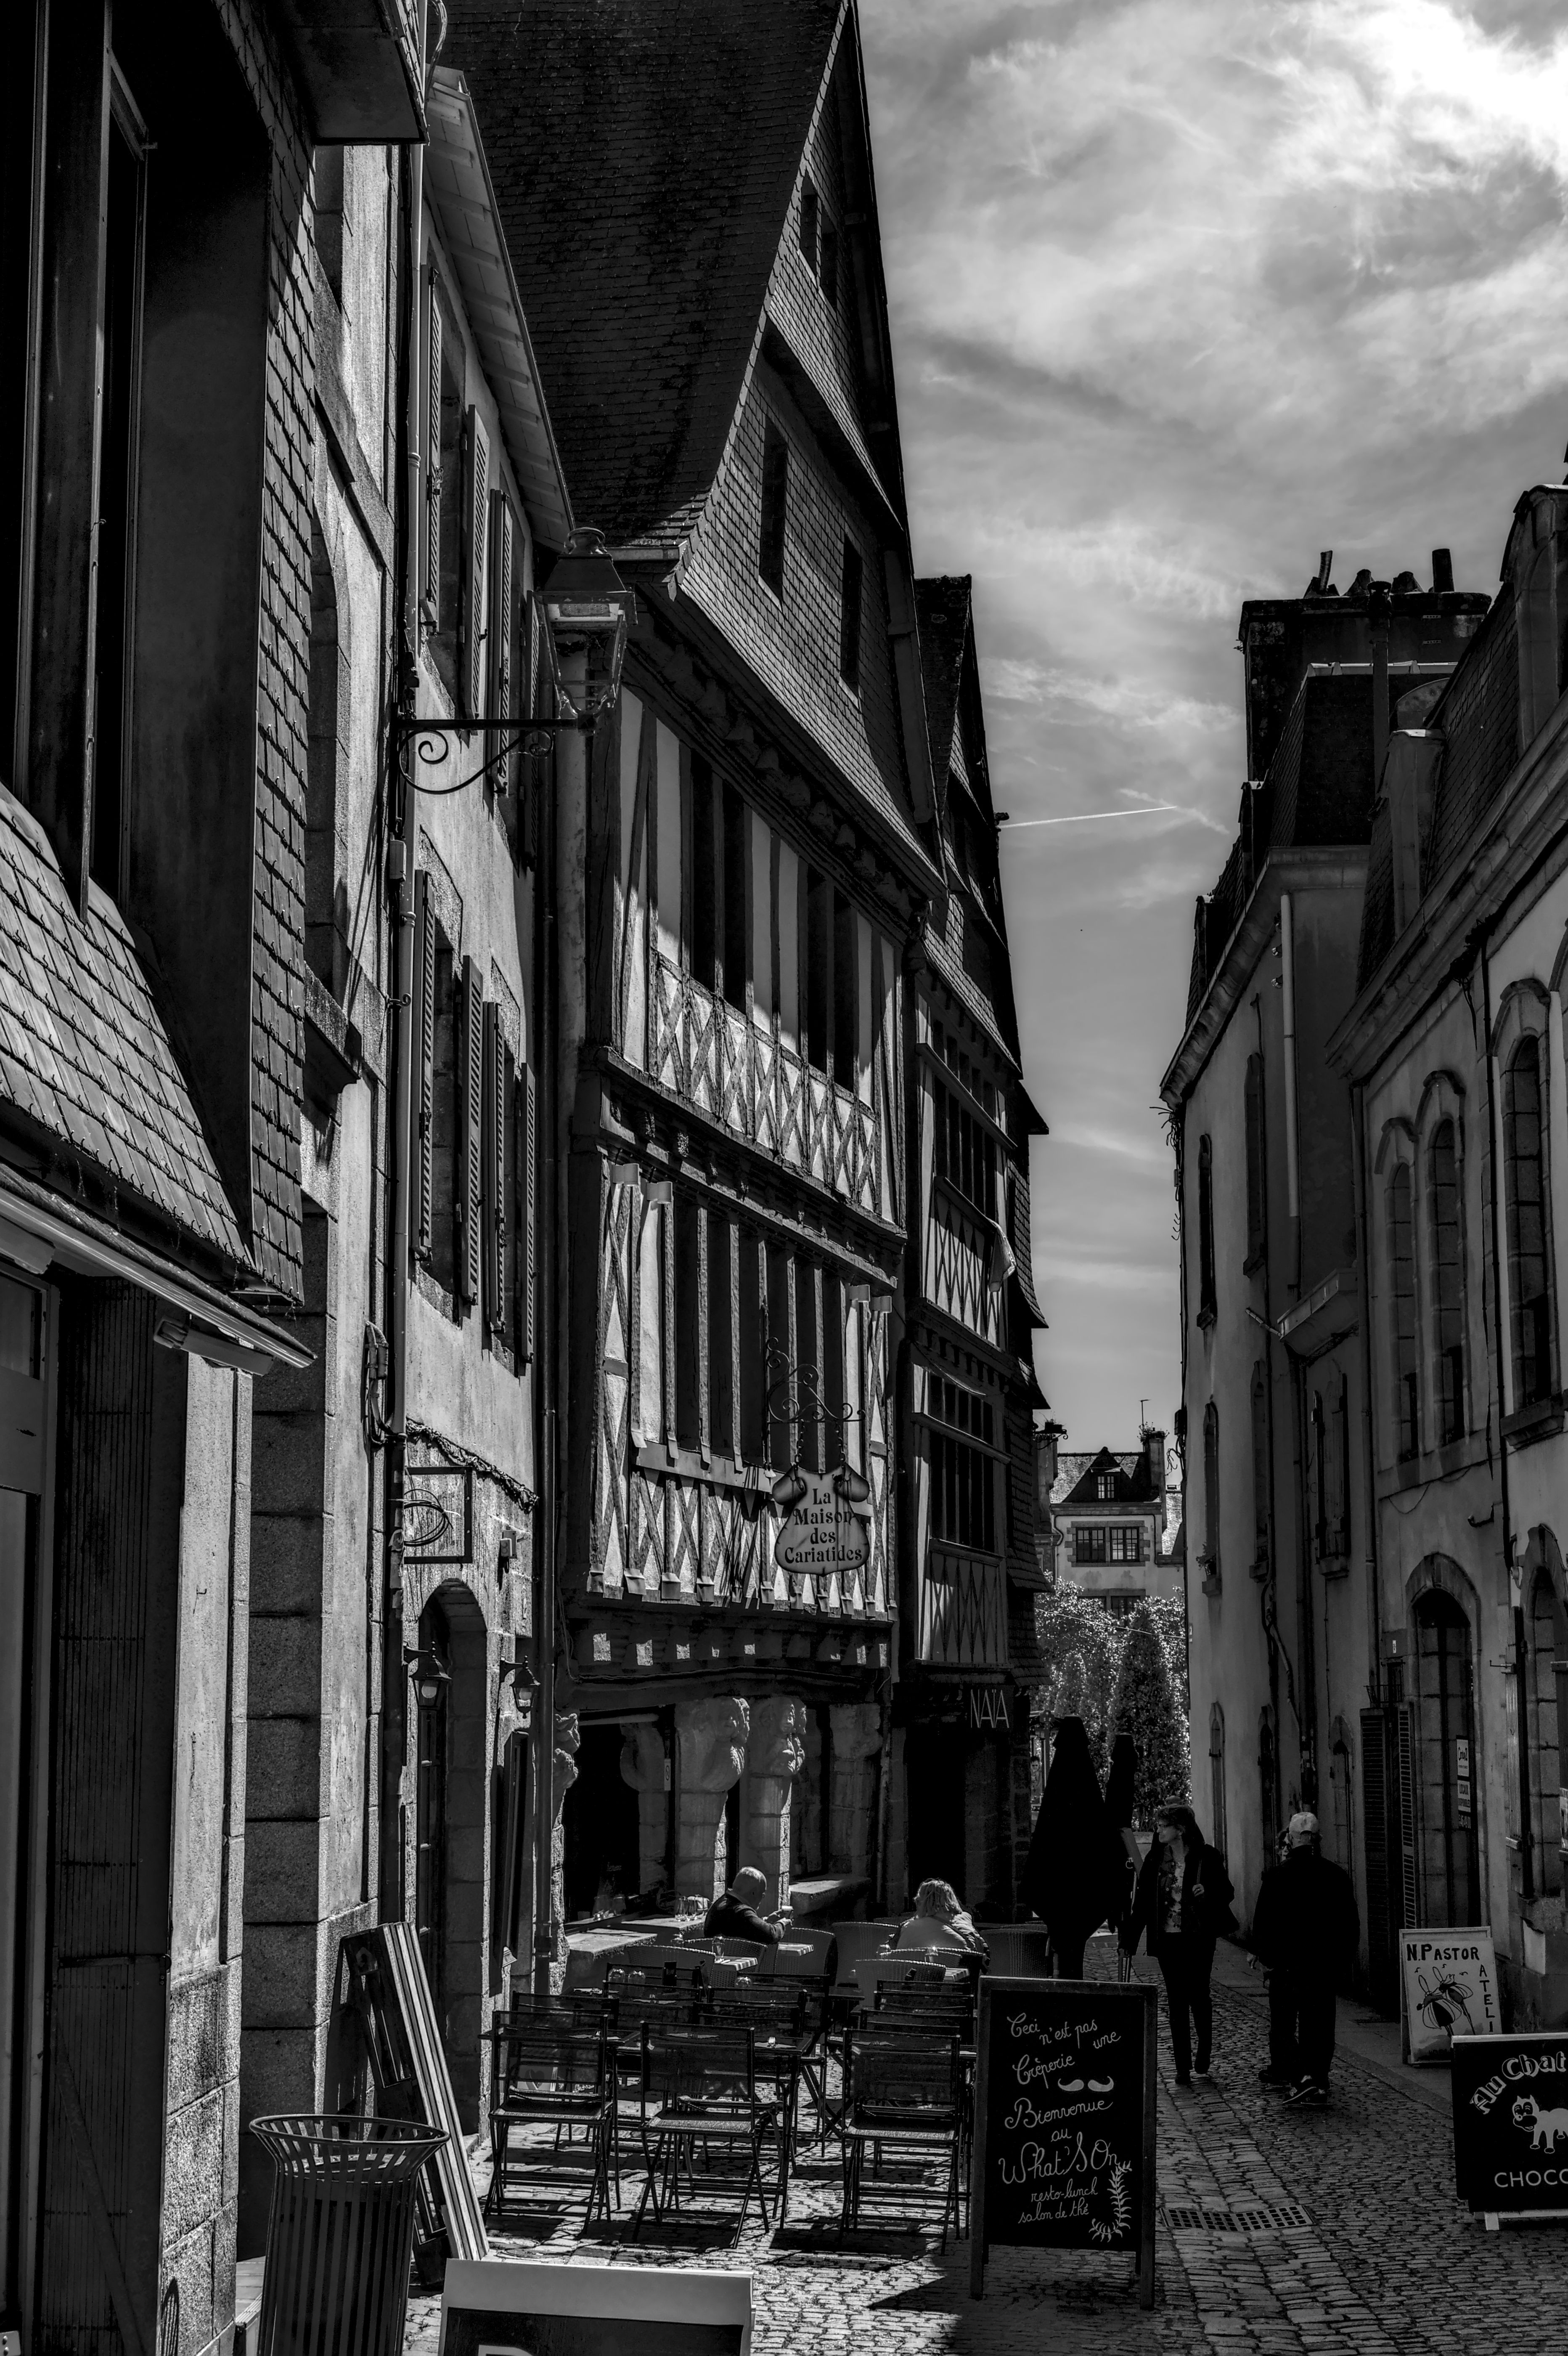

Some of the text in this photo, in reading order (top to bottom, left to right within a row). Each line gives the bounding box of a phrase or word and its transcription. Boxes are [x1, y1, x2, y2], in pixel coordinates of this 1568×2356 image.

[812, 1488, 832, 1505] La
[793, 1507, 852, 1526] Maison
[810, 1528, 836, 1544] des
[784, 1545, 862, 1564] Cariatides
[1479, 1964, 1495, 2032] ATELI
[1006, 2012, 1098, 2049] Ceci n'est pas
[1092, 2031, 1122, 2049] une
[1469, 2051, 1567, 2115] Au Chat
[1004, 2097, 1114, 2129] Bienvenue
[1051, 2128, 1073, 2142] au
[1030, 2176, 1099, 2203] resto-lunch
[1017, 2197, 1089, 2224] salon de thé
